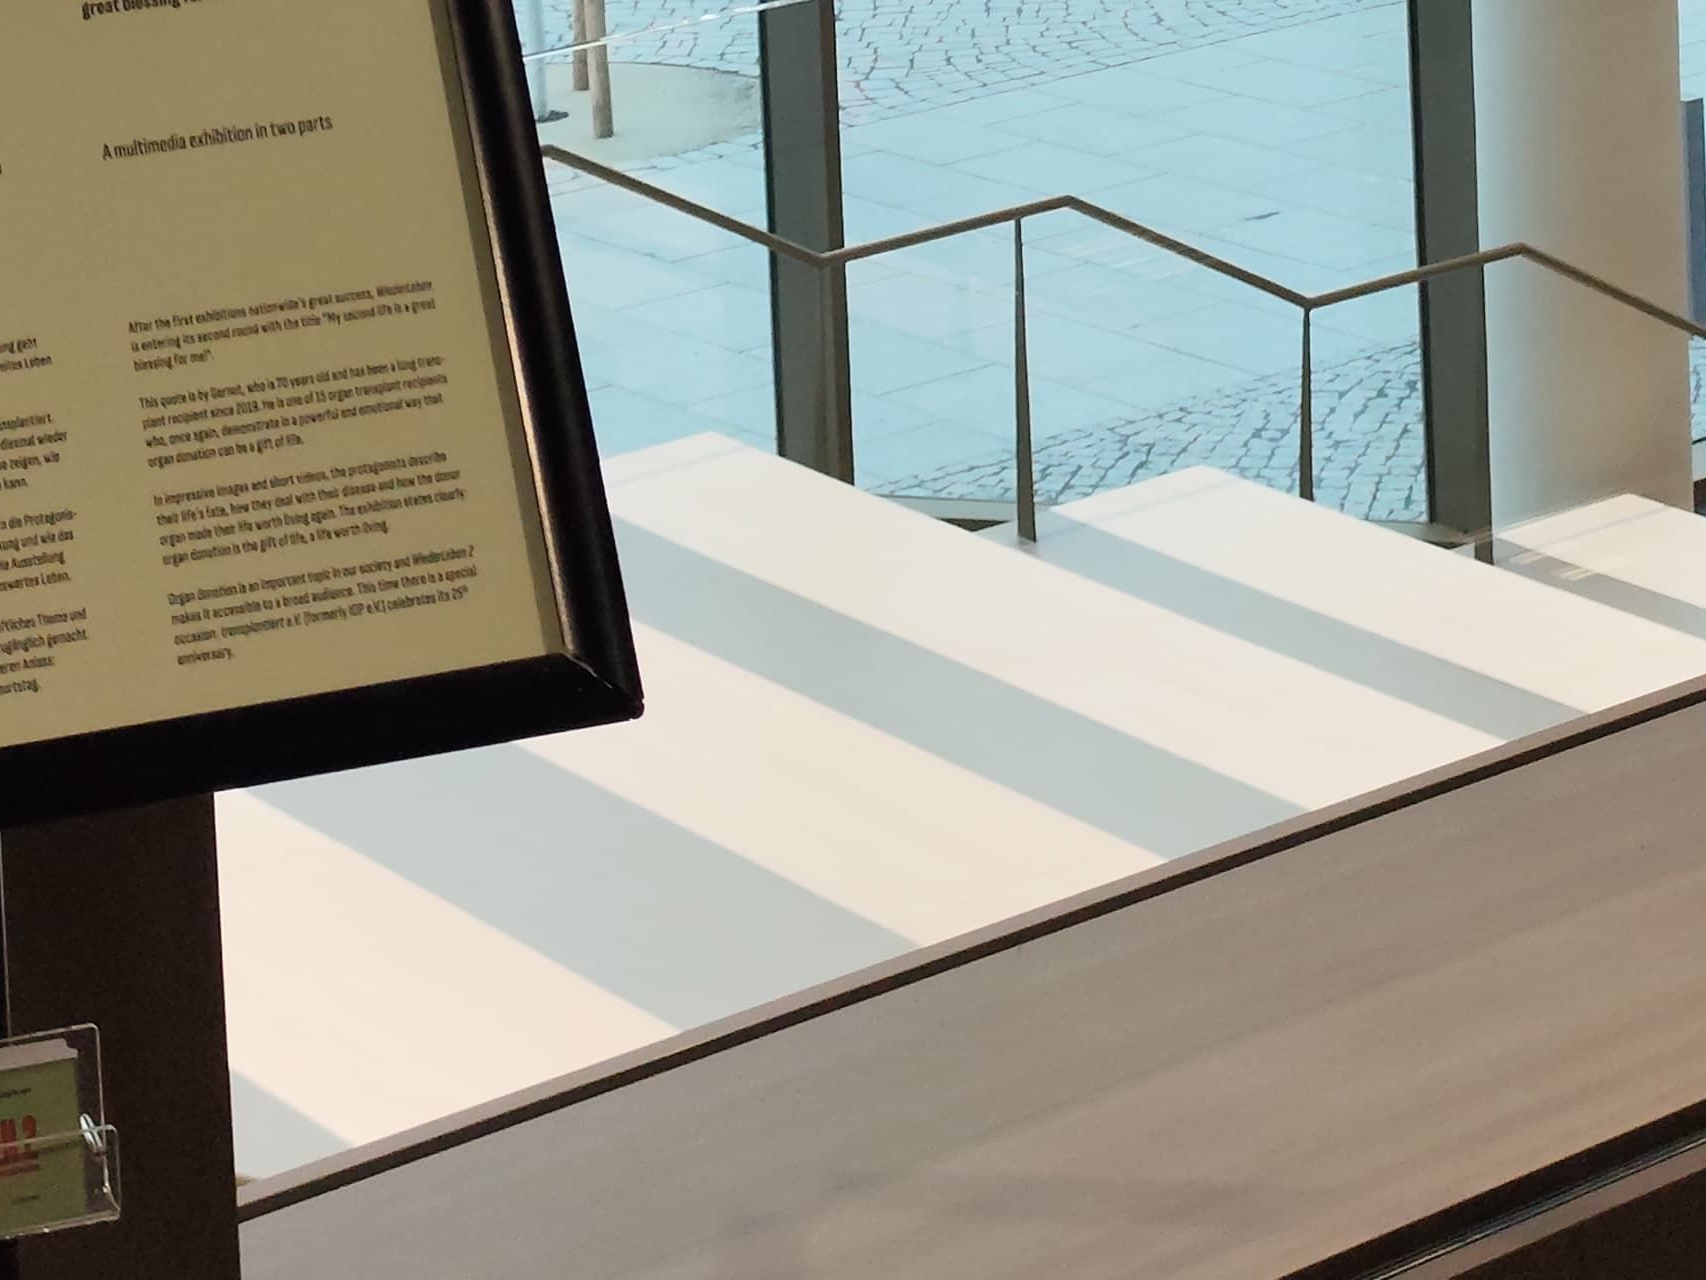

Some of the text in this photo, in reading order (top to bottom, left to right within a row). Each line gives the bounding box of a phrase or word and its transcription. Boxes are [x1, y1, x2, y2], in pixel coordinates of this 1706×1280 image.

[101, 115, 333, 161] A multimedia exhibition in two parts
